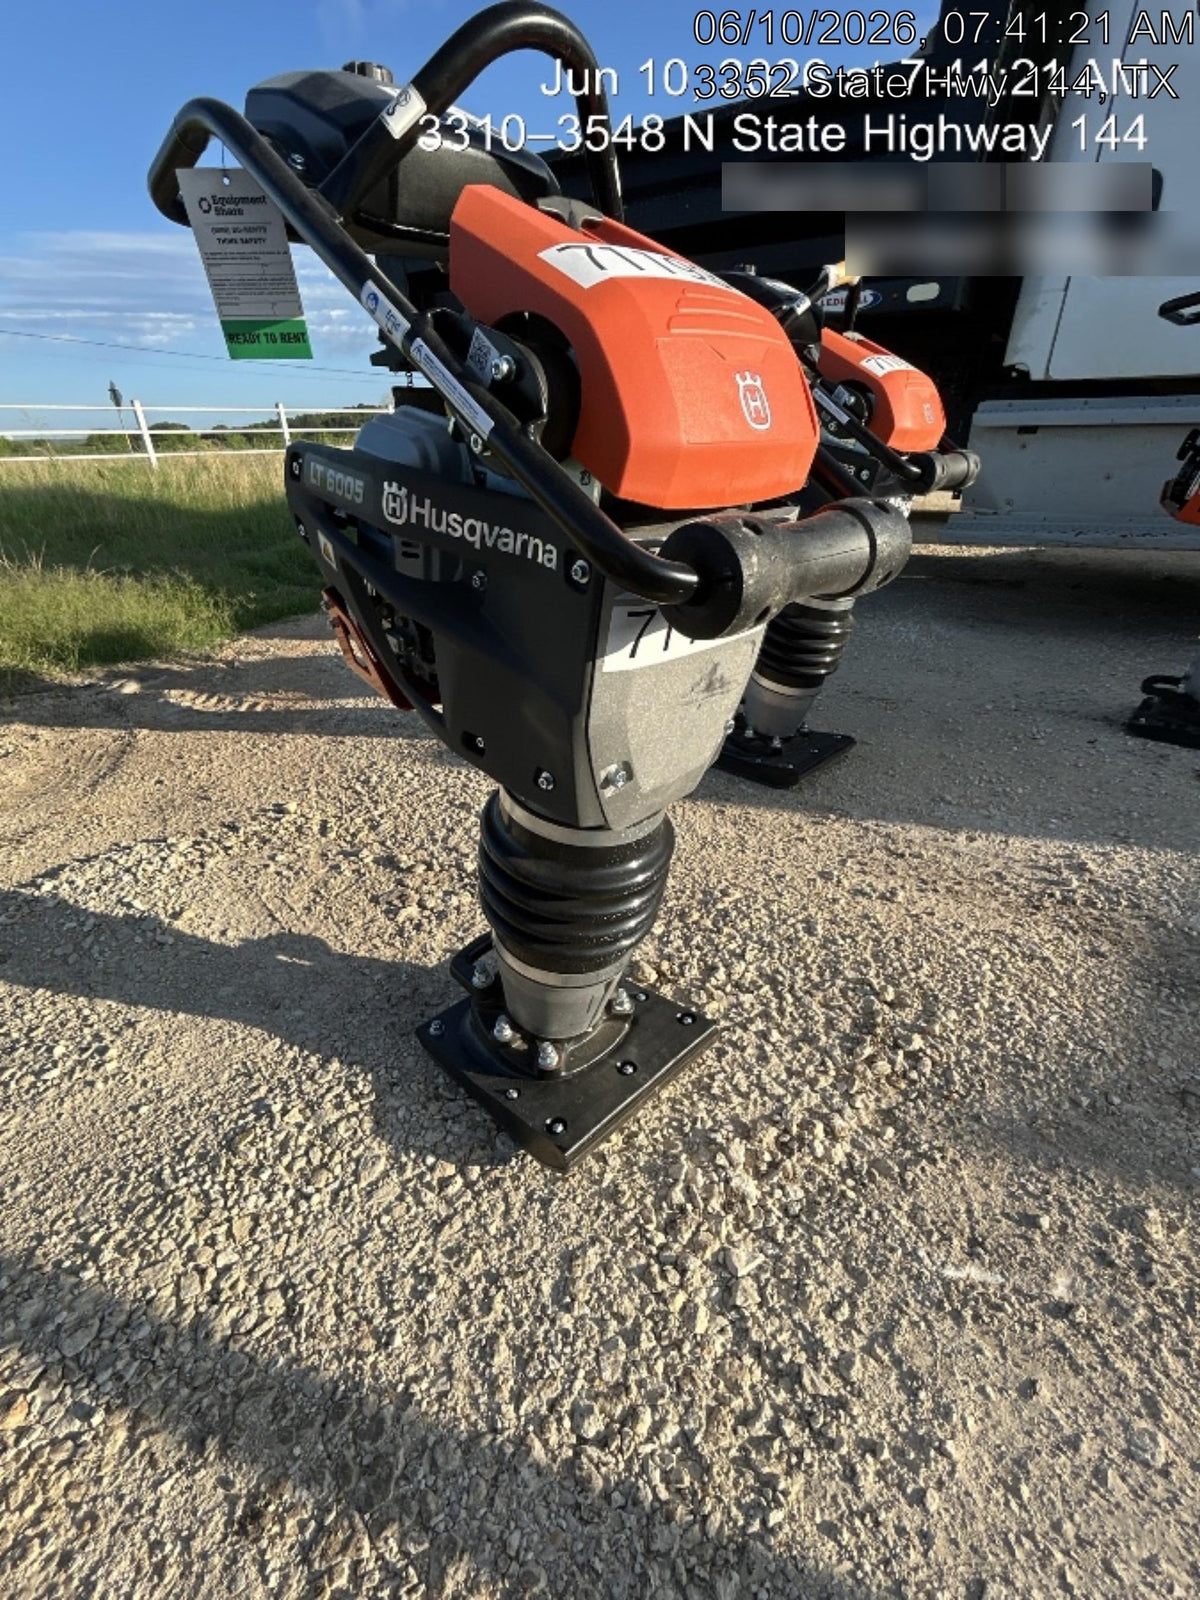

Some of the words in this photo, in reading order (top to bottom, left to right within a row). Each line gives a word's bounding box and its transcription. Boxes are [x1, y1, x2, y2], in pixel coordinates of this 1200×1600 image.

[227, 331, 260, 345] READY
[263, 331, 278, 344] TO
[280, 331, 307, 344] RENT
[310, 461, 324, 487] LT
[327, 468, 364, 504] 6005
[410, 493, 558, 570] Husqvarna
